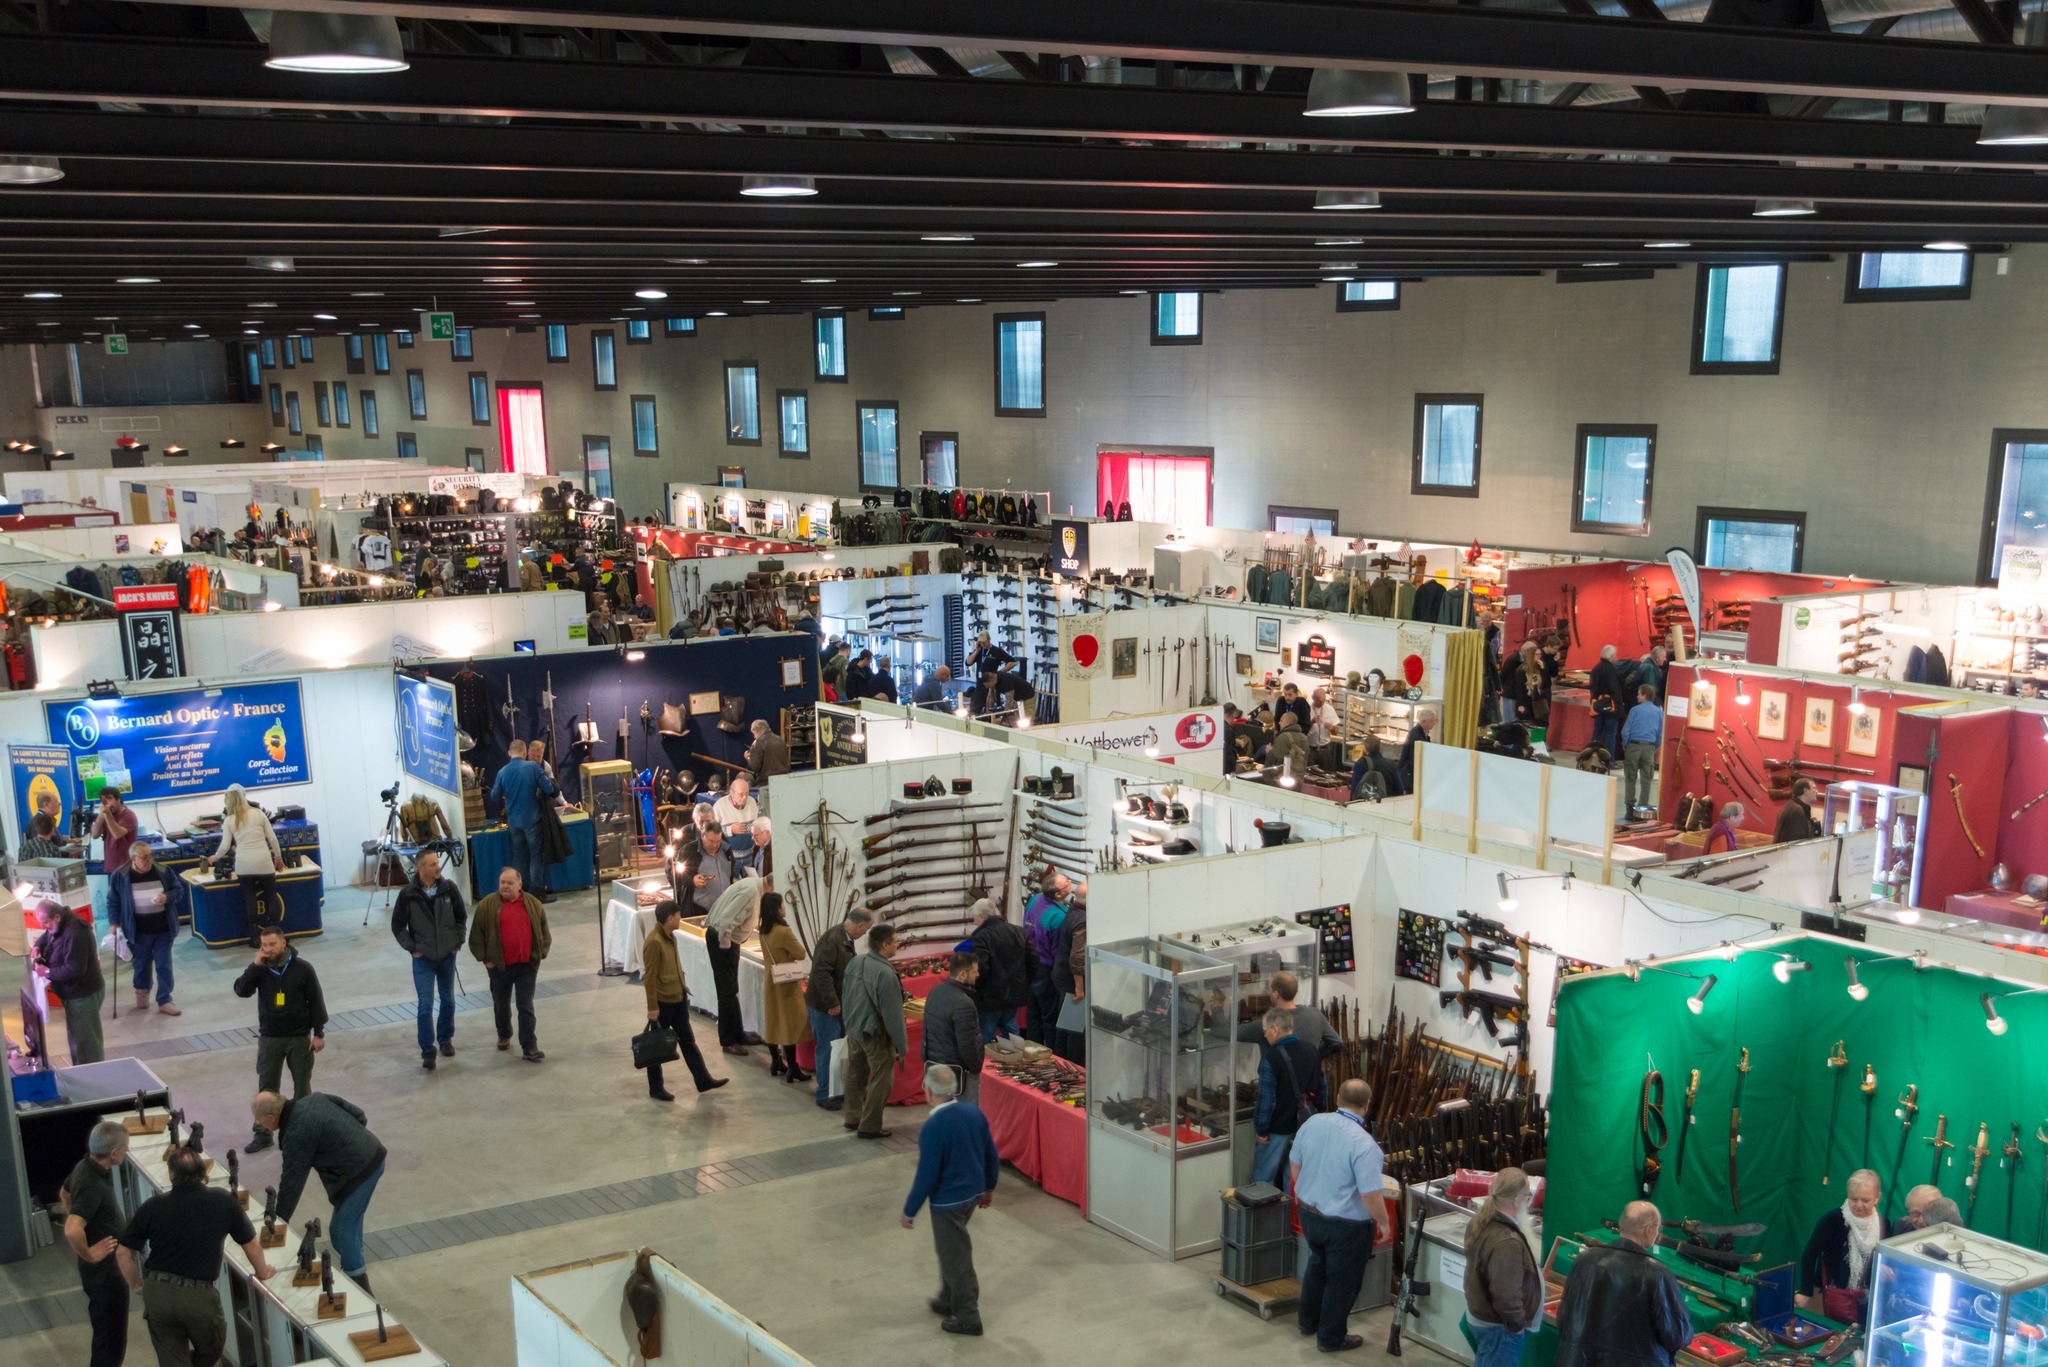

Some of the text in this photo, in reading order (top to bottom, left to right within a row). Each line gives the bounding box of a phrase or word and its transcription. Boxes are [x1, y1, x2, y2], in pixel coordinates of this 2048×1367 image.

[444, 475, 480, 483] SECURITY
[1061, 558, 1079, 570] SHOP
[118, 590, 176, 604] JACK'S KNIVES
[106, 712, 173, 731] Bernard
[176, 707, 220, 725] Optic
[233, 702, 286, 718] France
[425, 711, 444, 728] France
[154, 742, 211, 754] Vision nocturne
[164, 751, 204, 762] Anti reflets
[34, 759, 69, 767] INTELLIGENTE
[166, 760, 204, 770] Anti chocs
[248, 759, 271, 768] Corse
[152, 771, 180, 781] Traitées
[192, 766, 220, 777] baryum
[259, 765, 299, 776] Collection
[170, 778, 204, 788] Etanches
[256, 899, 266, 915] B
